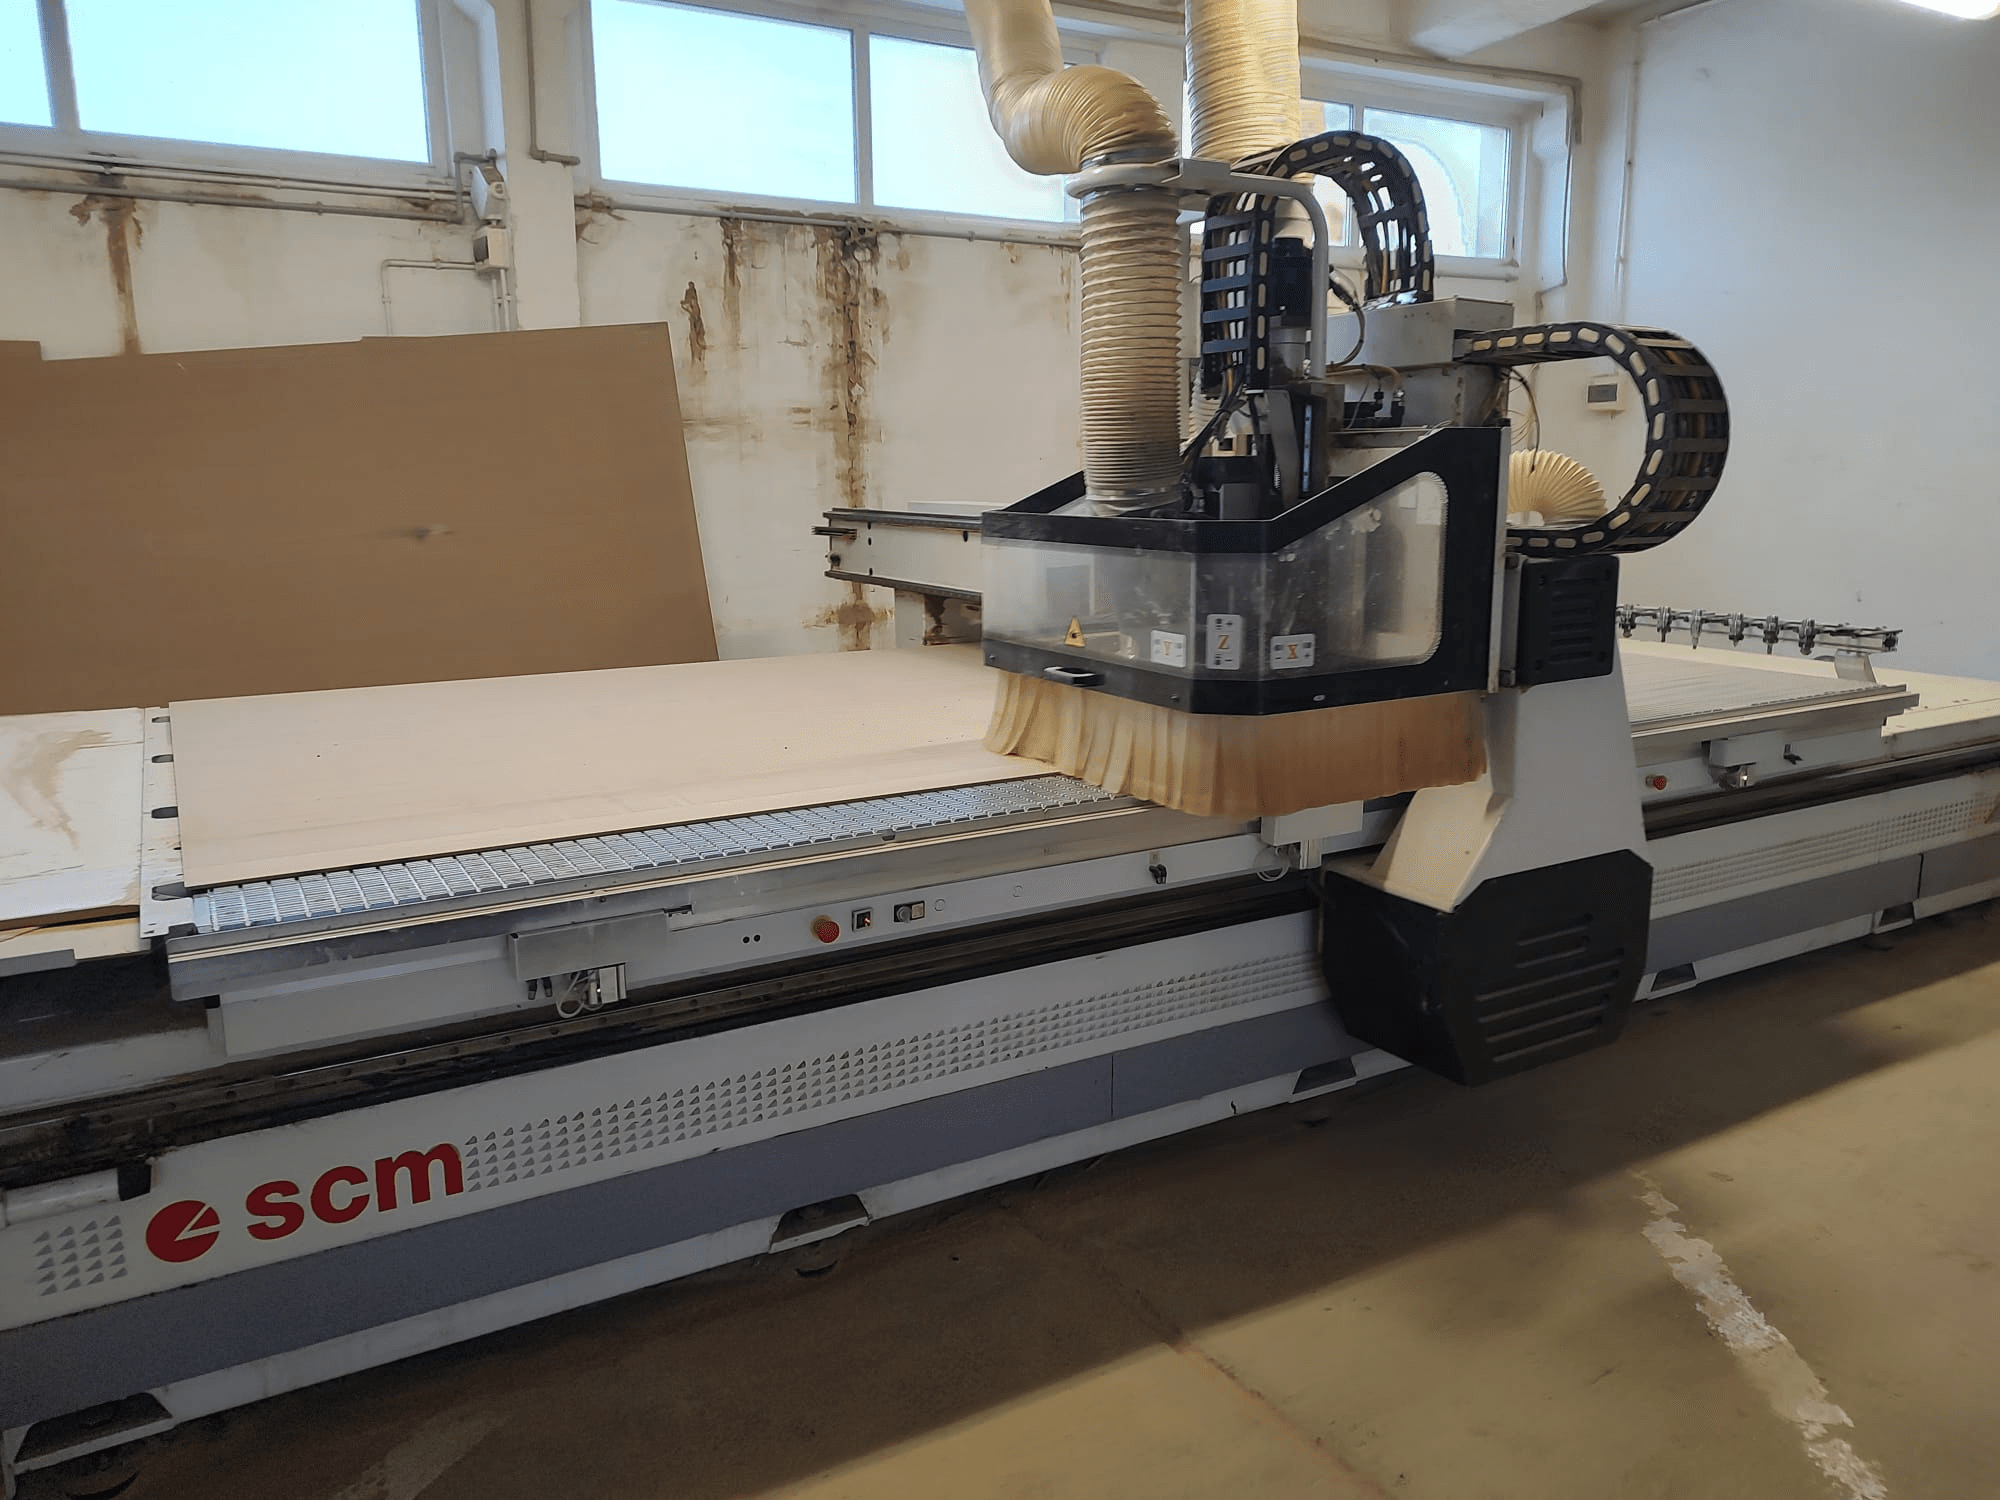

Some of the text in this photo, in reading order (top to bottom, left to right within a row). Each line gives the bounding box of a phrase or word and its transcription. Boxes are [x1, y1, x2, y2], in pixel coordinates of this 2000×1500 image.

[1218, 634, 1230, 650] Z
[1287, 644, 1299, 660] X
[245, 1142, 464, 1241] scm
